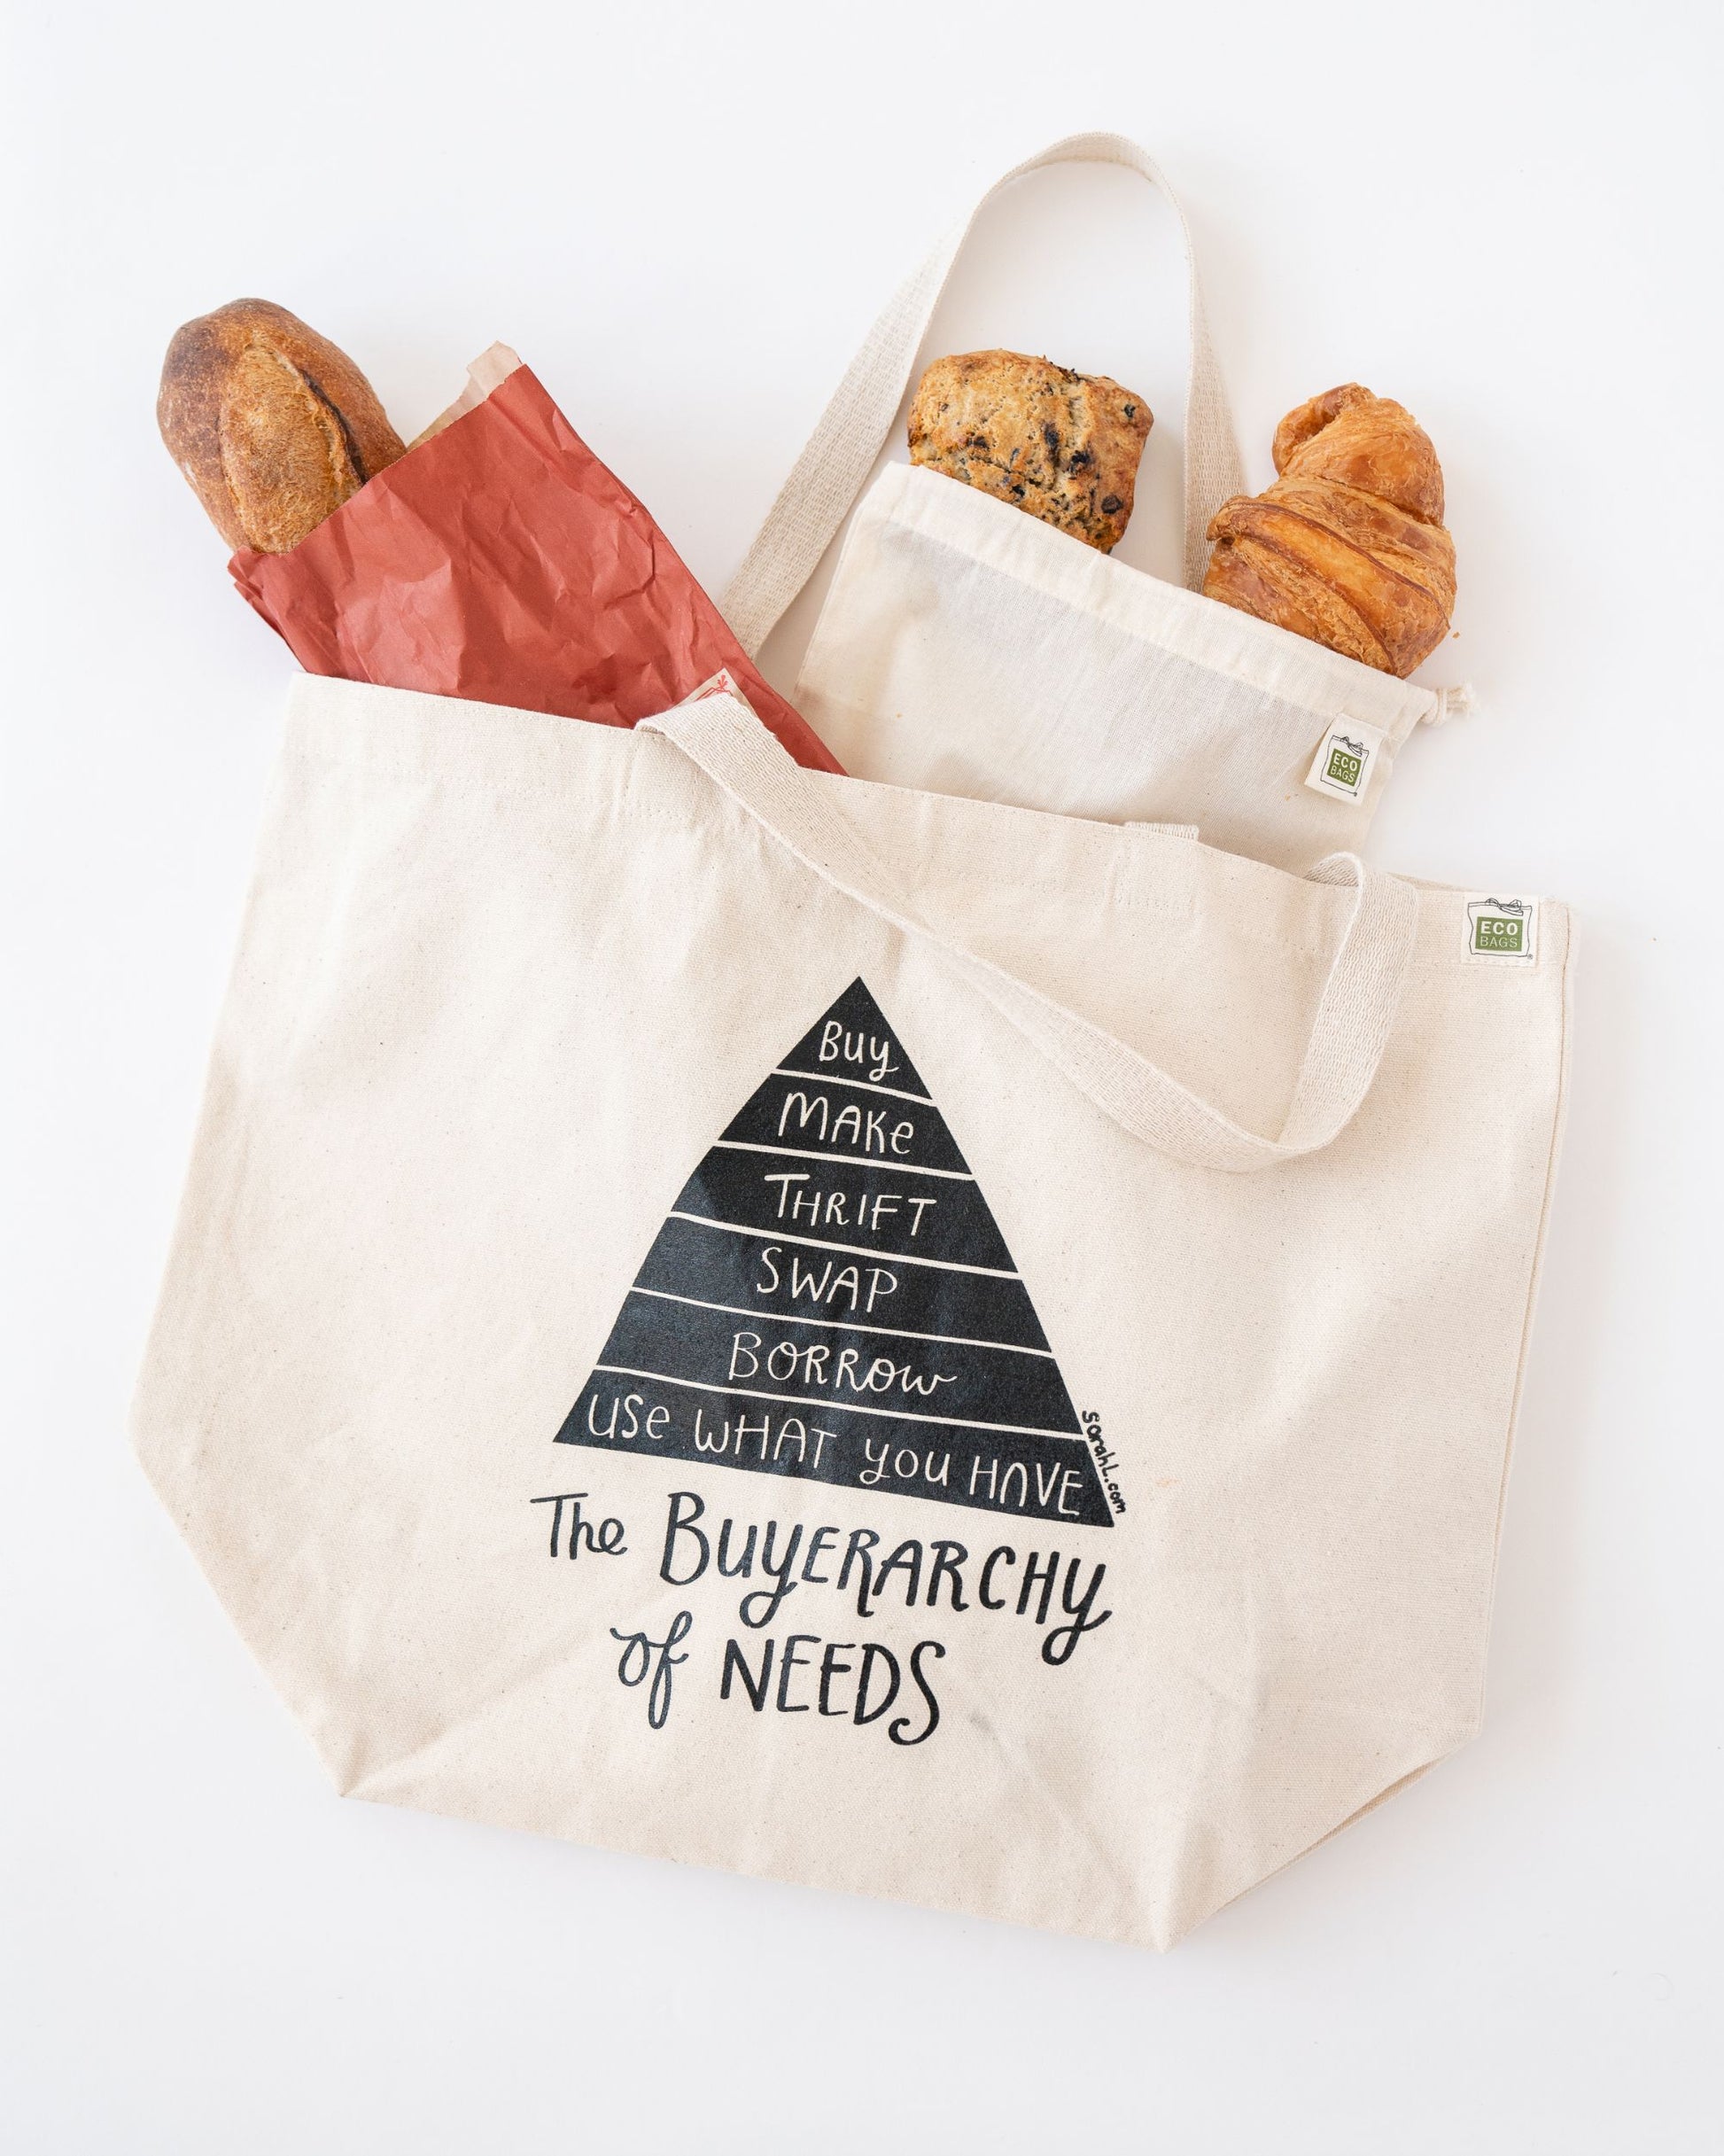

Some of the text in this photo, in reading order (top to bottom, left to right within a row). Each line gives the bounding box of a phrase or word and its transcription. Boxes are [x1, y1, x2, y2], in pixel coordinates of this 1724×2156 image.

[1330, 765, 1356, 783] BAGS
[1333, 753, 1358, 772] ECO
[1479, 937, 1518, 948] BAGS
[1480, 921, 1518, 936] ECO
[764, 1173, 938, 1237] THRIFT
[756, 1246, 898, 1313] SWAP
[693, 1409, 838, 1470] WHAT
[969, 1454, 1084, 1516] HAVE
[530, 1491, 628, 1561] The
[610, 1609, 947, 1746] of NEEDS
